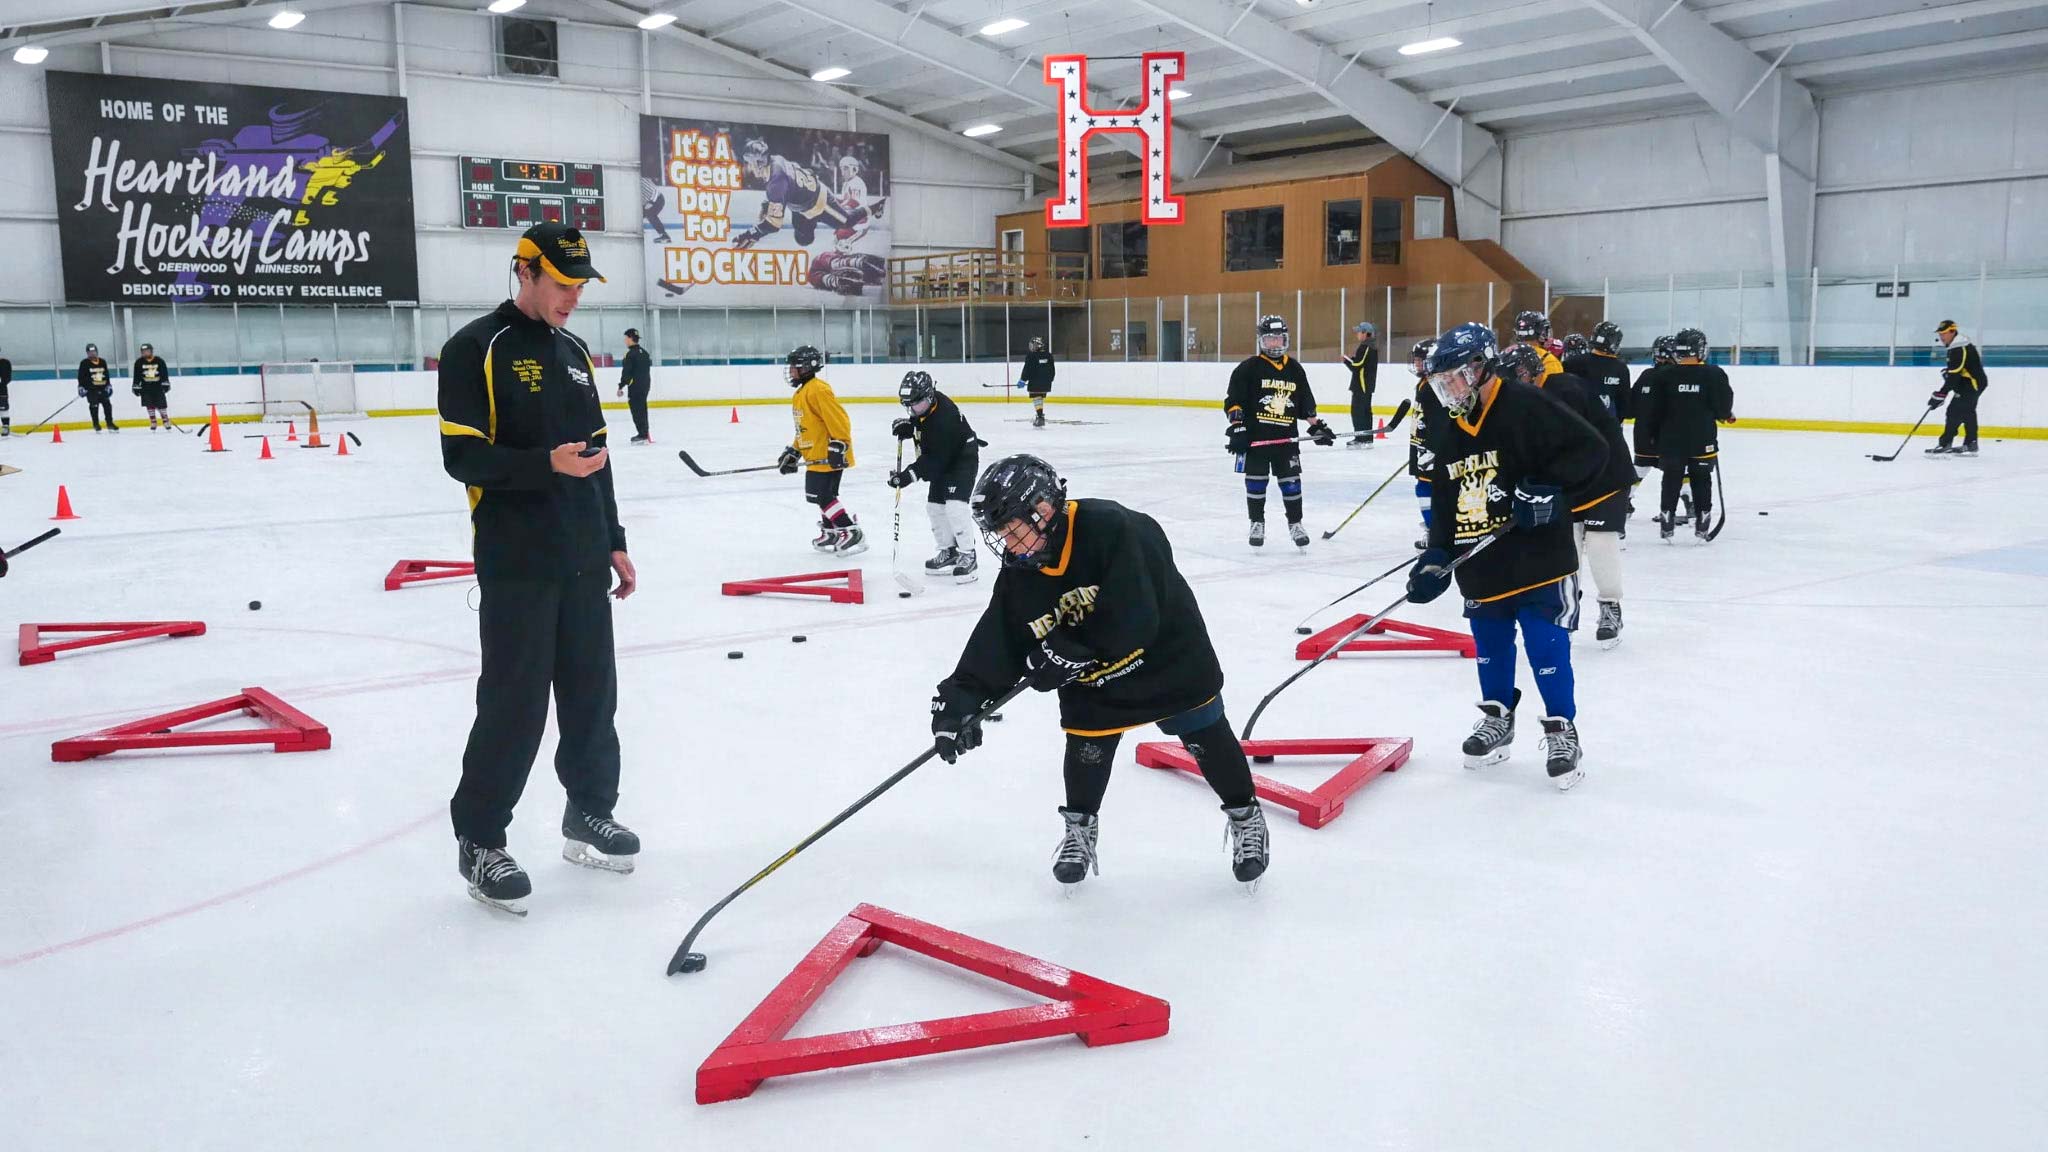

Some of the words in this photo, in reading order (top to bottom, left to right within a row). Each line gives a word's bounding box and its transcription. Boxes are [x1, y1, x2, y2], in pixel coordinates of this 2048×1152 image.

[101, 99, 154, 121] HOME
[162, 103, 186, 122] OF
[195, 105, 229, 125] THE
[673, 132, 709, 160] It's
[713, 135, 731, 160] A
[1043, 51, 1185, 228] H
[74, 136, 297, 213] Heartland
[519, 163, 558, 180] 4:27
[670, 160, 740, 188] Great
[471, 182, 495, 192] HOME
[571, 187, 599, 197] VISITOR
[680, 188, 729, 215] Day
[106, 200, 254, 275] Hockey
[258, 208, 371, 275] Camps
[686, 215, 728, 240] For
[158, 262, 228, 273] DEERWOOD
[254, 264, 322, 274] MINNESOTA
[666, 249, 809, 284] HOCKEY!
[122, 283, 204, 297] DEDICATED
[211, 284, 231, 297] TO
[237, 284, 294, 297] HOCKEY
[301, 285, 383, 297] EXCELLENCE
[1104, 658, 1145, 681] MINNESOTA
